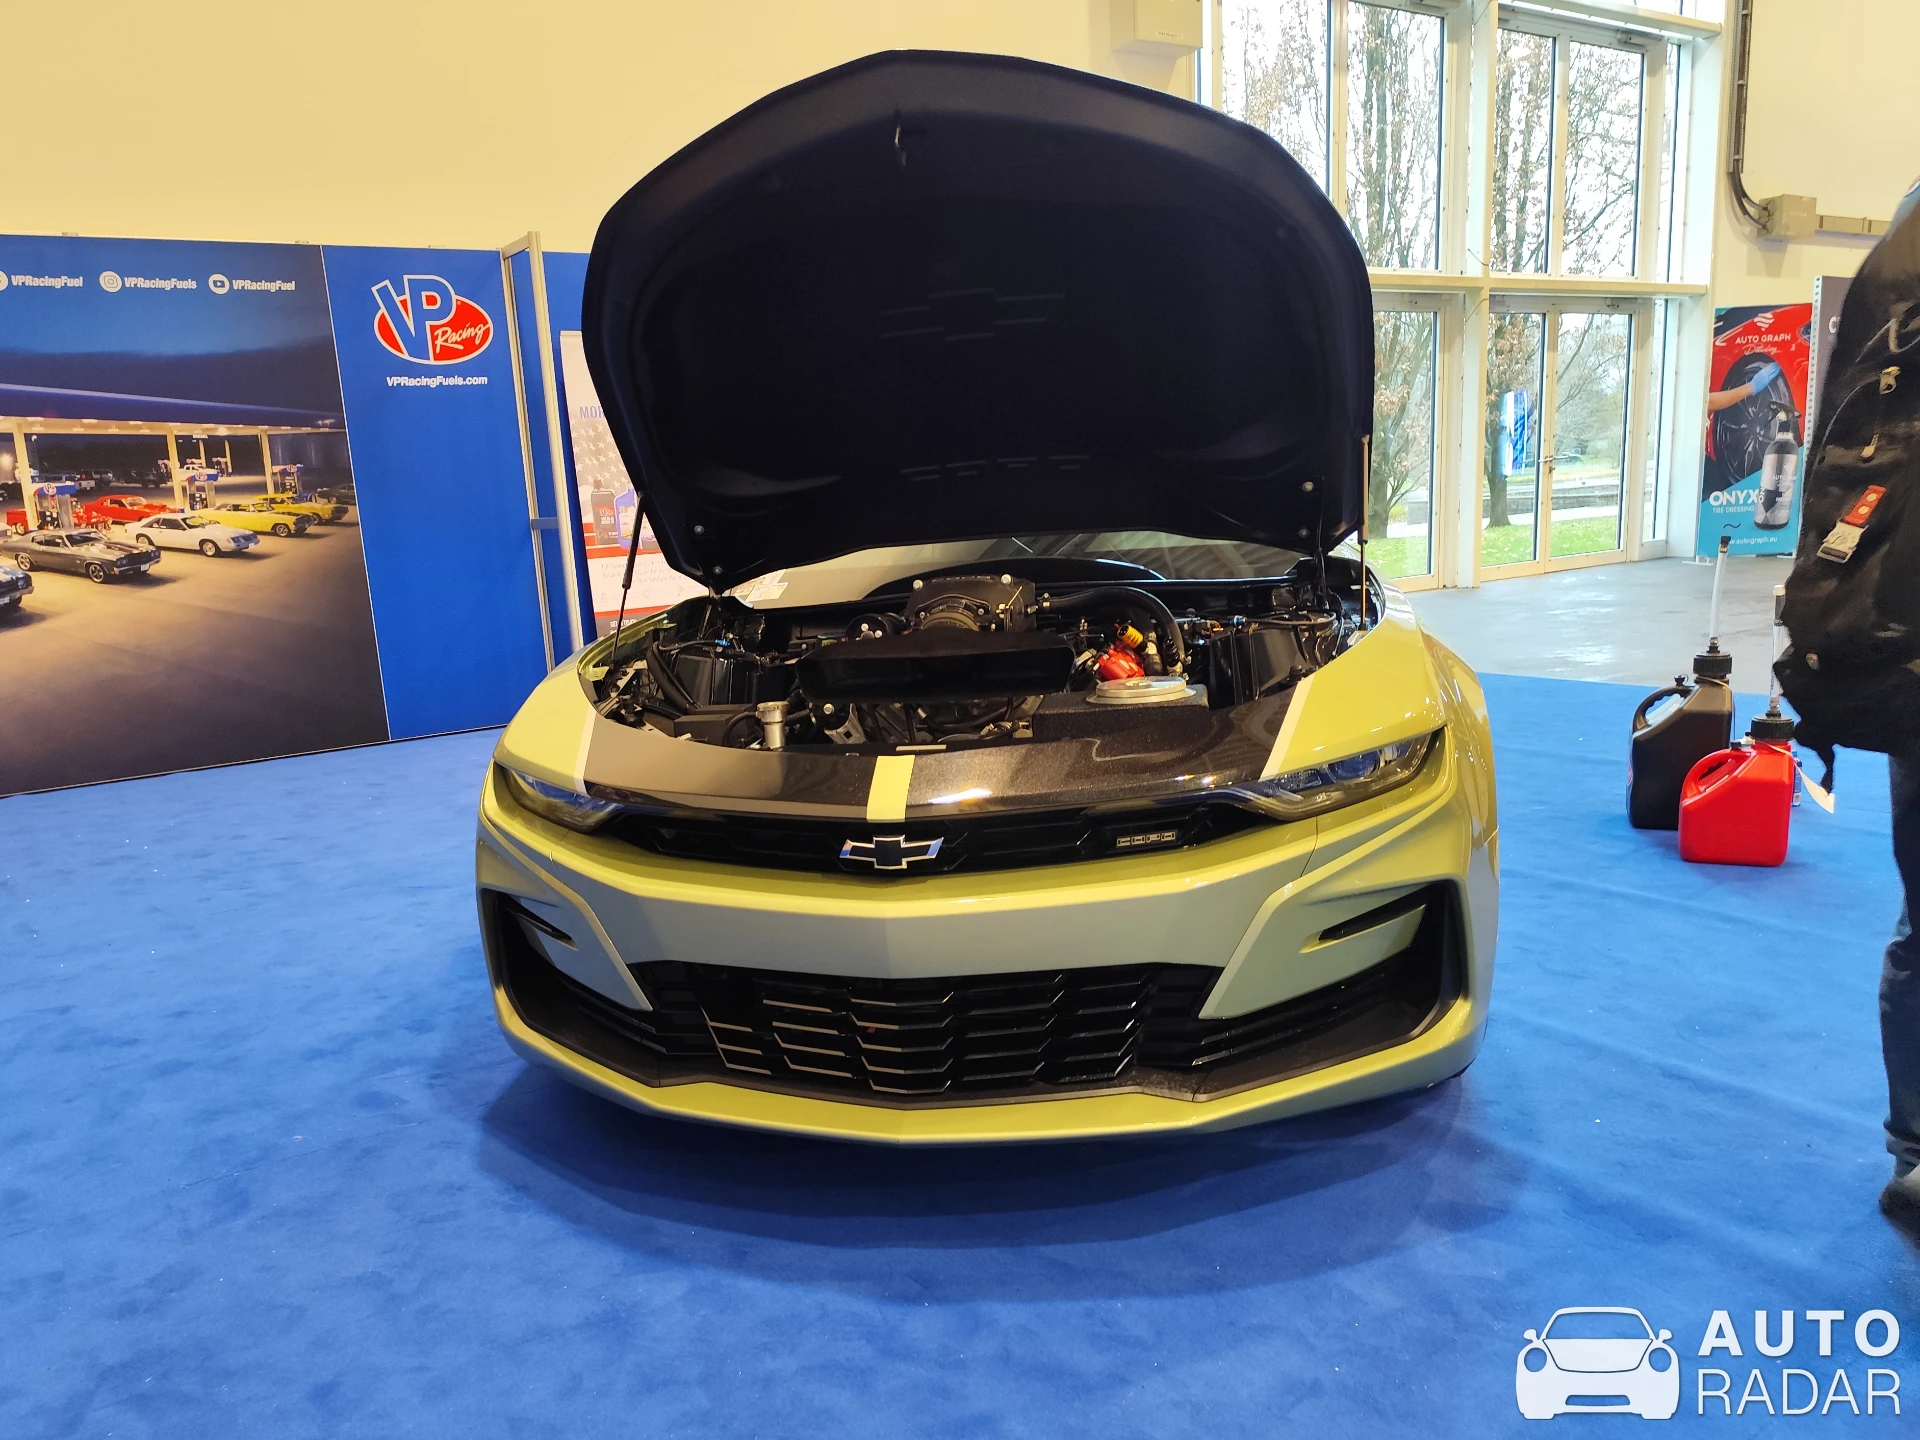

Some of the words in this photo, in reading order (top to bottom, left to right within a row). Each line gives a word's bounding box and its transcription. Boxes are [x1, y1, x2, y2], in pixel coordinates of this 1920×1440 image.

[11, 274, 83, 288] VPRacingFuel
[124, 276, 197, 290] VPRacingFuels
[232, 279, 296, 292] VPRacingFuel
[371, 275, 458, 364] VP
[434, 322, 490, 354] Racing
[1735, 335, 1759, 344] AUTO
[1761, 333, 1791, 342] GRAPH
[386, 375, 488, 388] VPRacingFuels.com
[1709, 488, 1759, 506] ONYX
